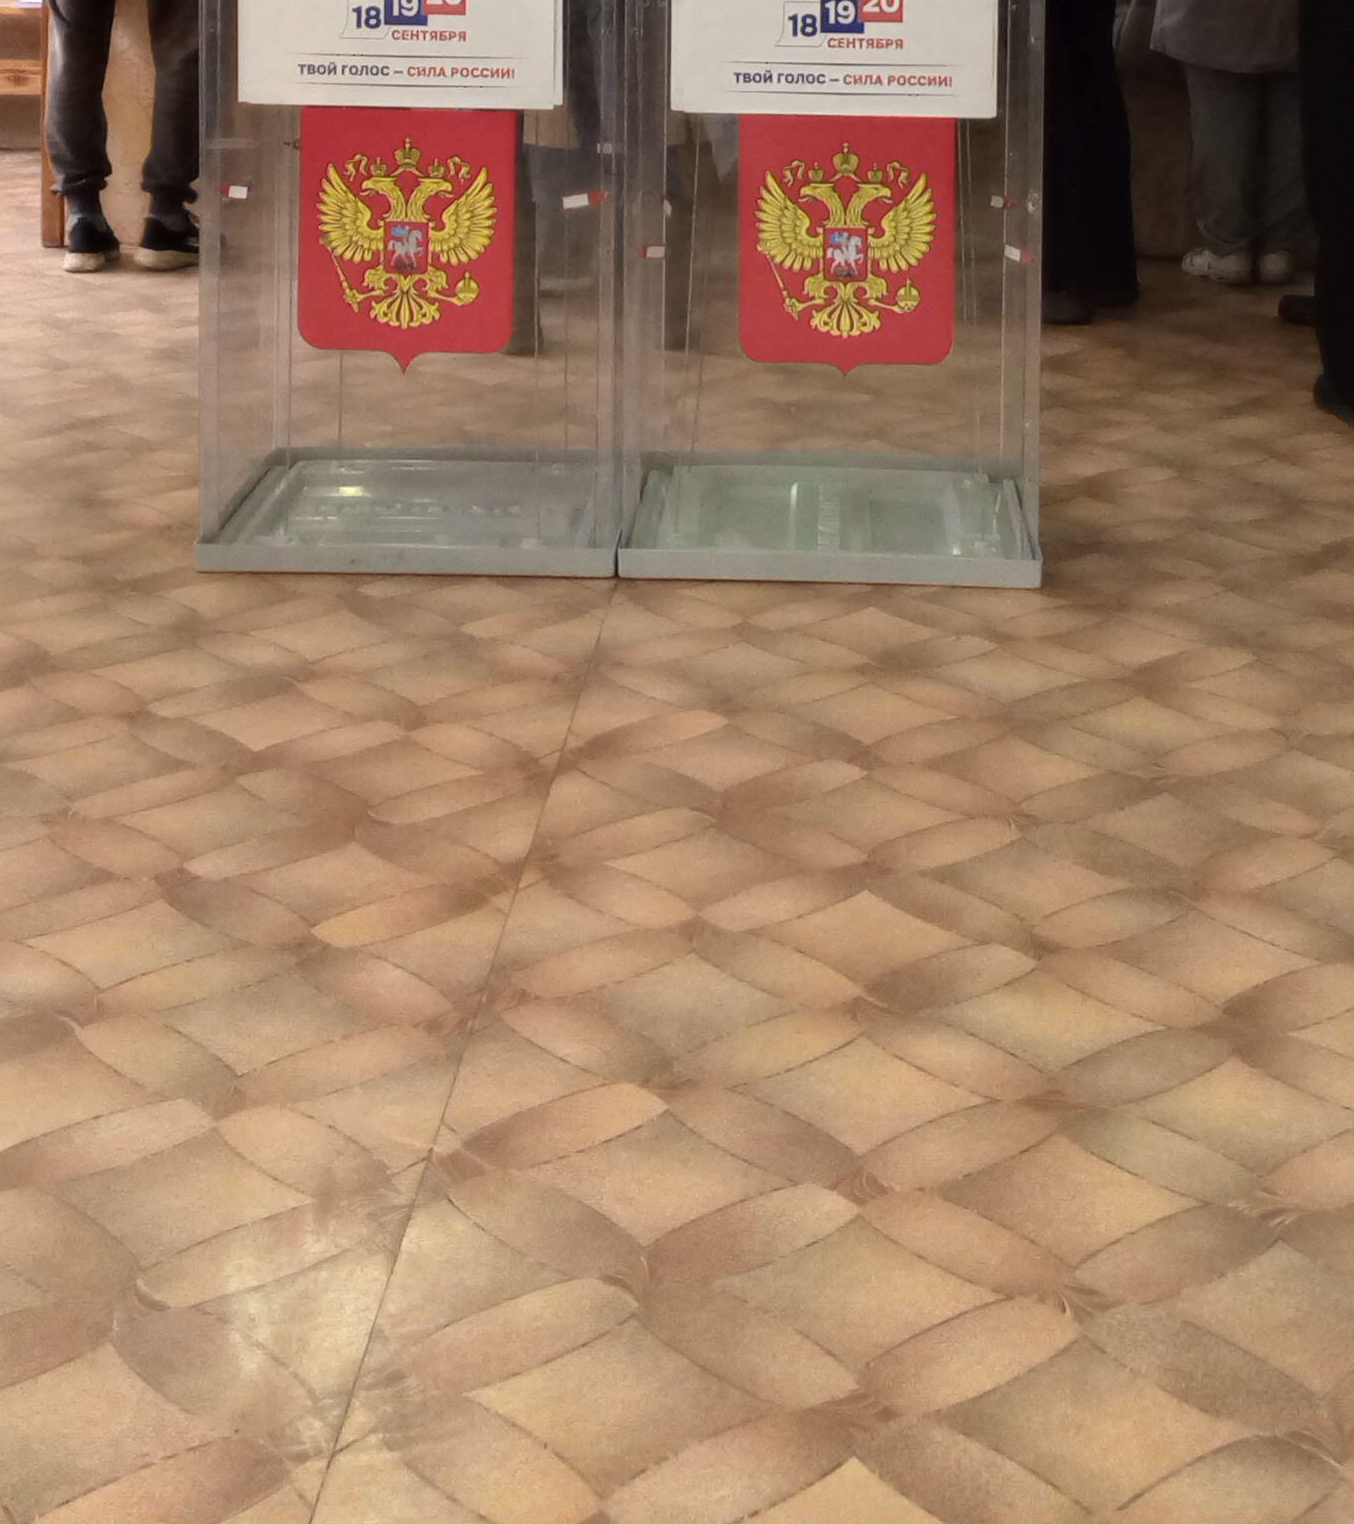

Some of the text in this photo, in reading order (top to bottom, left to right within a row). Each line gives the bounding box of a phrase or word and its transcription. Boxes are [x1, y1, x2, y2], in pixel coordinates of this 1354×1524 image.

[352, 5, 382, 29] 18
[788, 12, 818, 37] 18
[824, 0, 856, 25] 19
[391, 29, 467, 42] СЕНТЯБРЯ
[827, 38, 904, 49] СЕНТЯБРЯ
[298, 62, 337, 77] ТВОЙ
[341, 64, 390, 77] ГОЛОС
[407, 66, 447, 78] СИЛА
[451, 67, 515, 79] РОССИИ!
[733, 70, 773, 84] ТВОЙ
[777, 73, 826, 84] ГОЛОС
[843, 74, 883, 86] СИЛА
[887, 75, 953, 87] РОССИИ!
